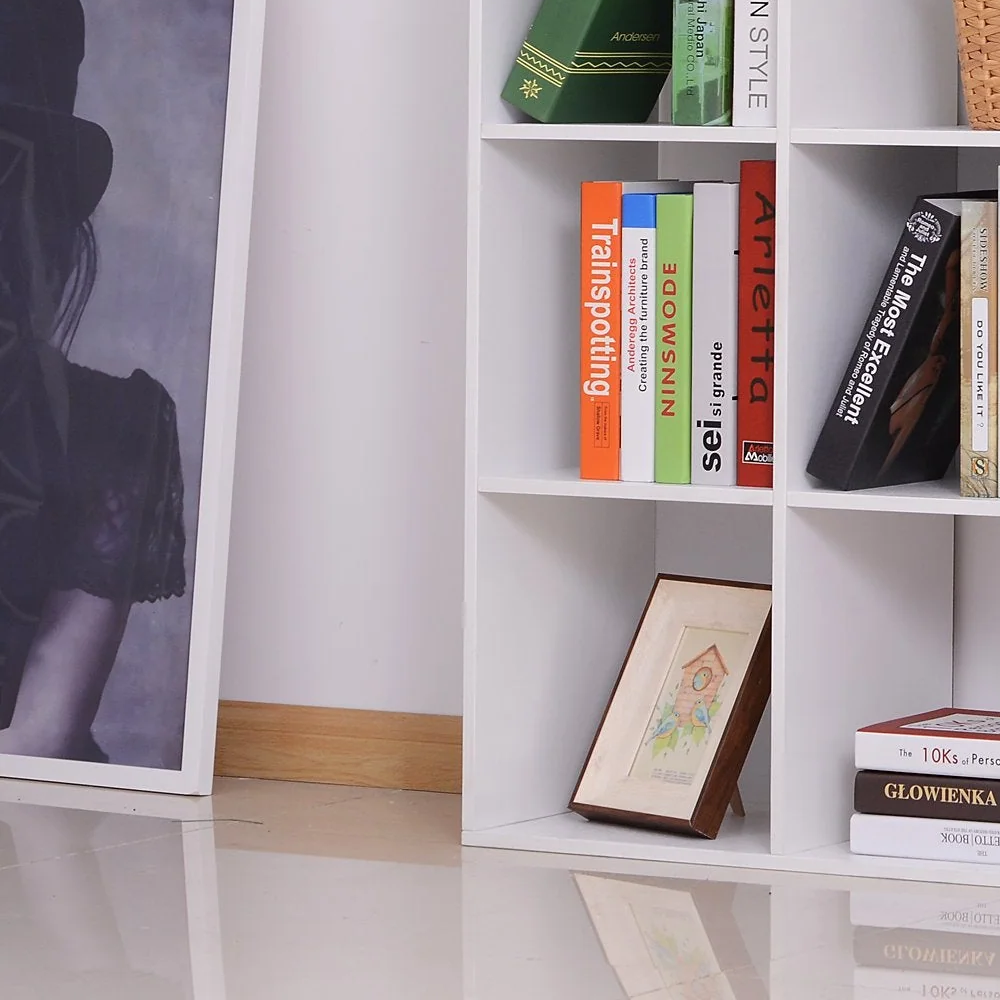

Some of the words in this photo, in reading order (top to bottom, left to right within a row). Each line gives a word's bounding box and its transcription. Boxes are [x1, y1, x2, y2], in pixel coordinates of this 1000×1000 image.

[610, 31, 660, 43] Andersen
[694, 17, 707, 58] Japan
[748, 27, 768, 109] STYLE
[640, 238, 649, 270] brand
[899, 246, 909, 263] and
[901, 254, 927, 286] The
[980, 228, 988, 292] SIDESHOW
[627, 258, 637, 315] Architects
[639, 274, 648, 320] furniture
[583, 218, 618, 397] Trainspotting
[880, 289, 911, 337] Most
[639, 325, 648, 342] the
[661, 263, 677, 417] NINSMODE
[976, 320, 983, 338] DO
[627, 318, 638, 373] Anderegg
[863, 341, 871, 351] of
[639, 345, 649, 392] Creating
[710, 341, 725, 398] grande
[851, 350, 868, 379] Romeo
[844, 338, 891, 425] Excellent
[845, 380, 855, 396] and
[709, 402, 722, 416] si
[976, 405, 983, 418] IT
[696, 420, 722, 472] sei
[899, 749, 913, 758] The
[922, 747, 959, 764] 10Ks
[962, 758, 969, 766] of
[884, 782, 998, 807] GŁOWIENKA
[941, 832, 969, 845] BOOK
